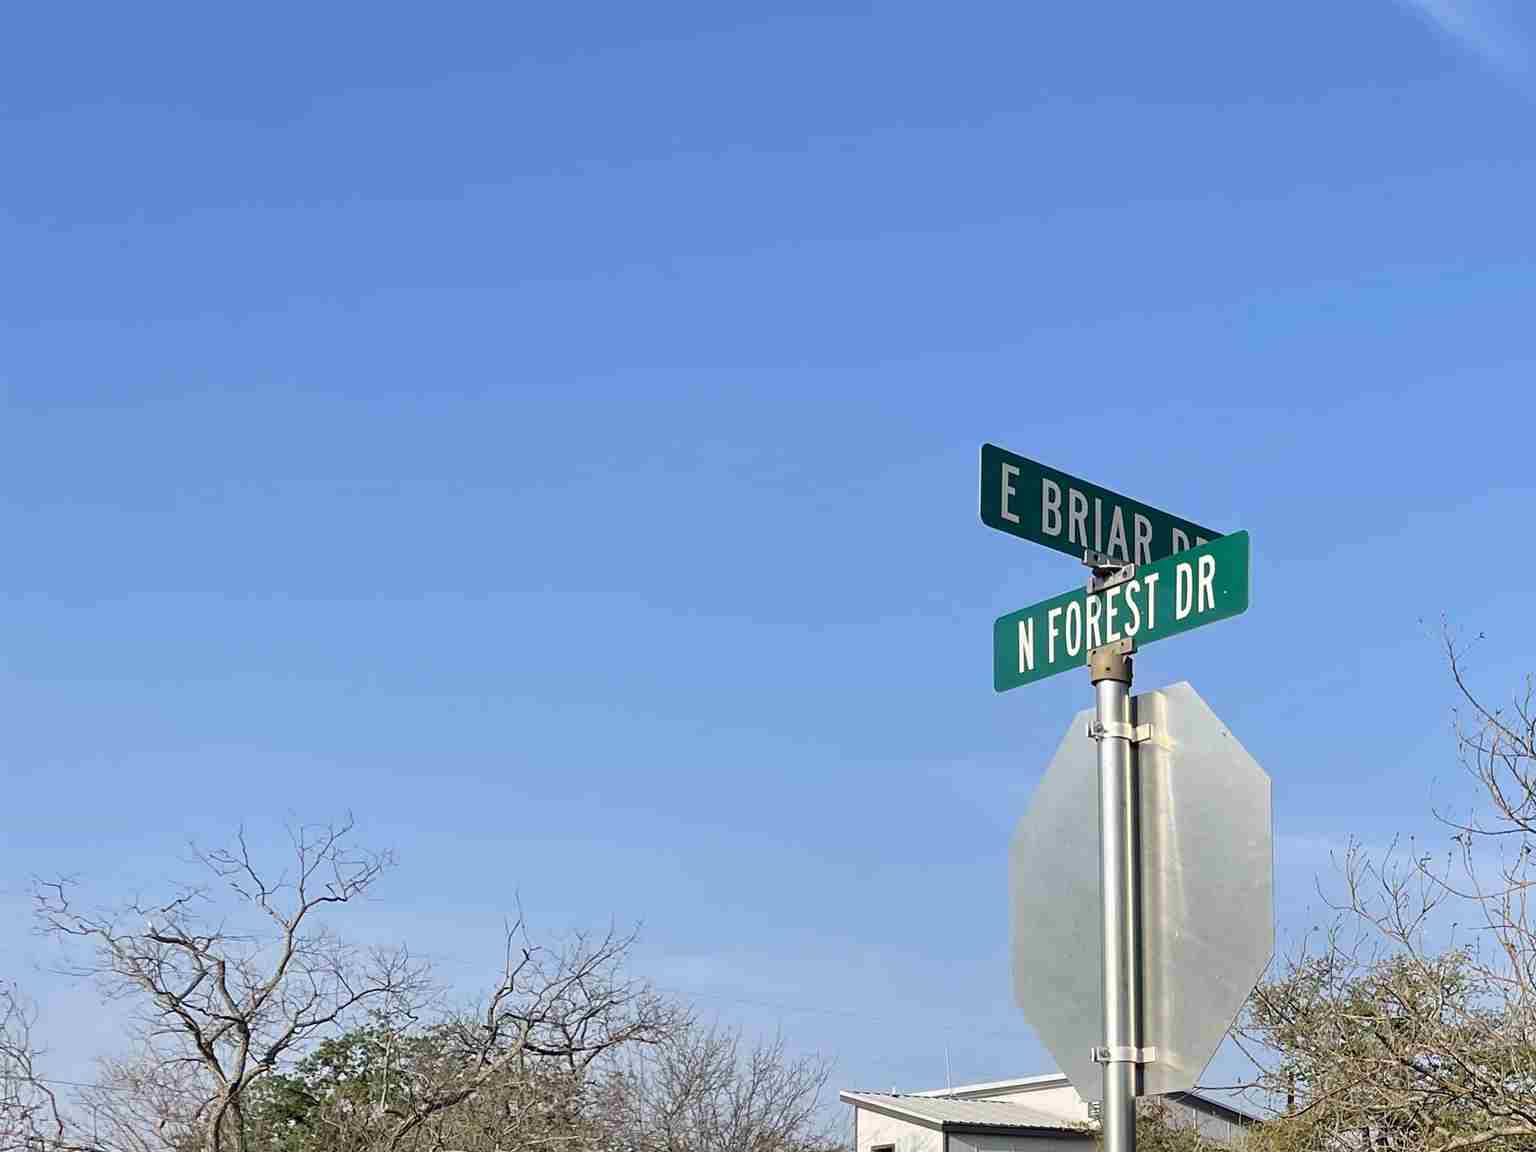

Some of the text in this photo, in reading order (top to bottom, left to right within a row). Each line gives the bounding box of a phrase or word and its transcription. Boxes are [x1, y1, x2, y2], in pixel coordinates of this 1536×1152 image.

[1000, 462, 1209, 567] E BRIAR D
[1018, 554, 1216, 673] N FOREST DR
